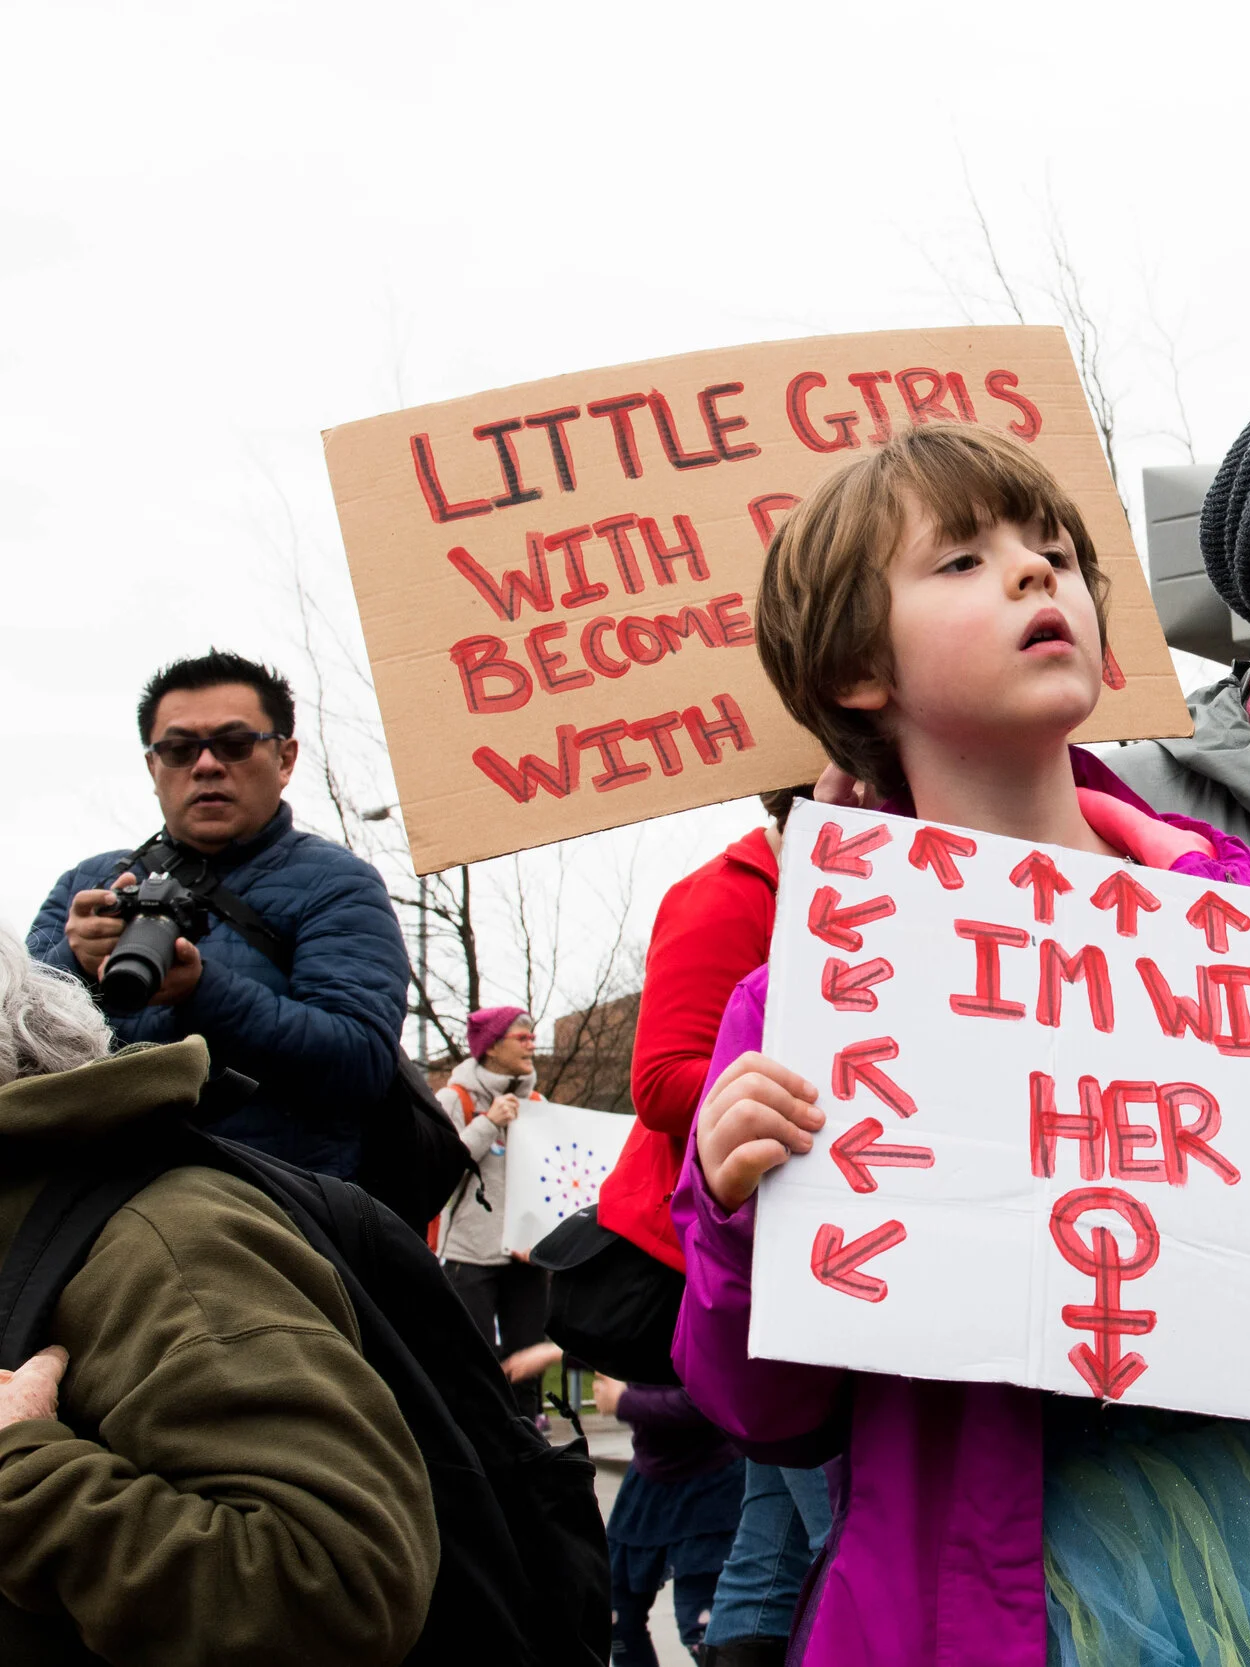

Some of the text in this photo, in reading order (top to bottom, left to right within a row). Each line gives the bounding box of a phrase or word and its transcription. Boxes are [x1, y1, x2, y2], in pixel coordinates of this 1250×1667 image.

[410, 381, 762, 524] LITTLE
[786, 366, 1043, 453] GIRLS
[446, 512, 711, 621] WITH
[448, 592, 757, 715] BECOME
[471, 693, 756, 804] WITH
[1029, 1071, 1240, 1185] HER
